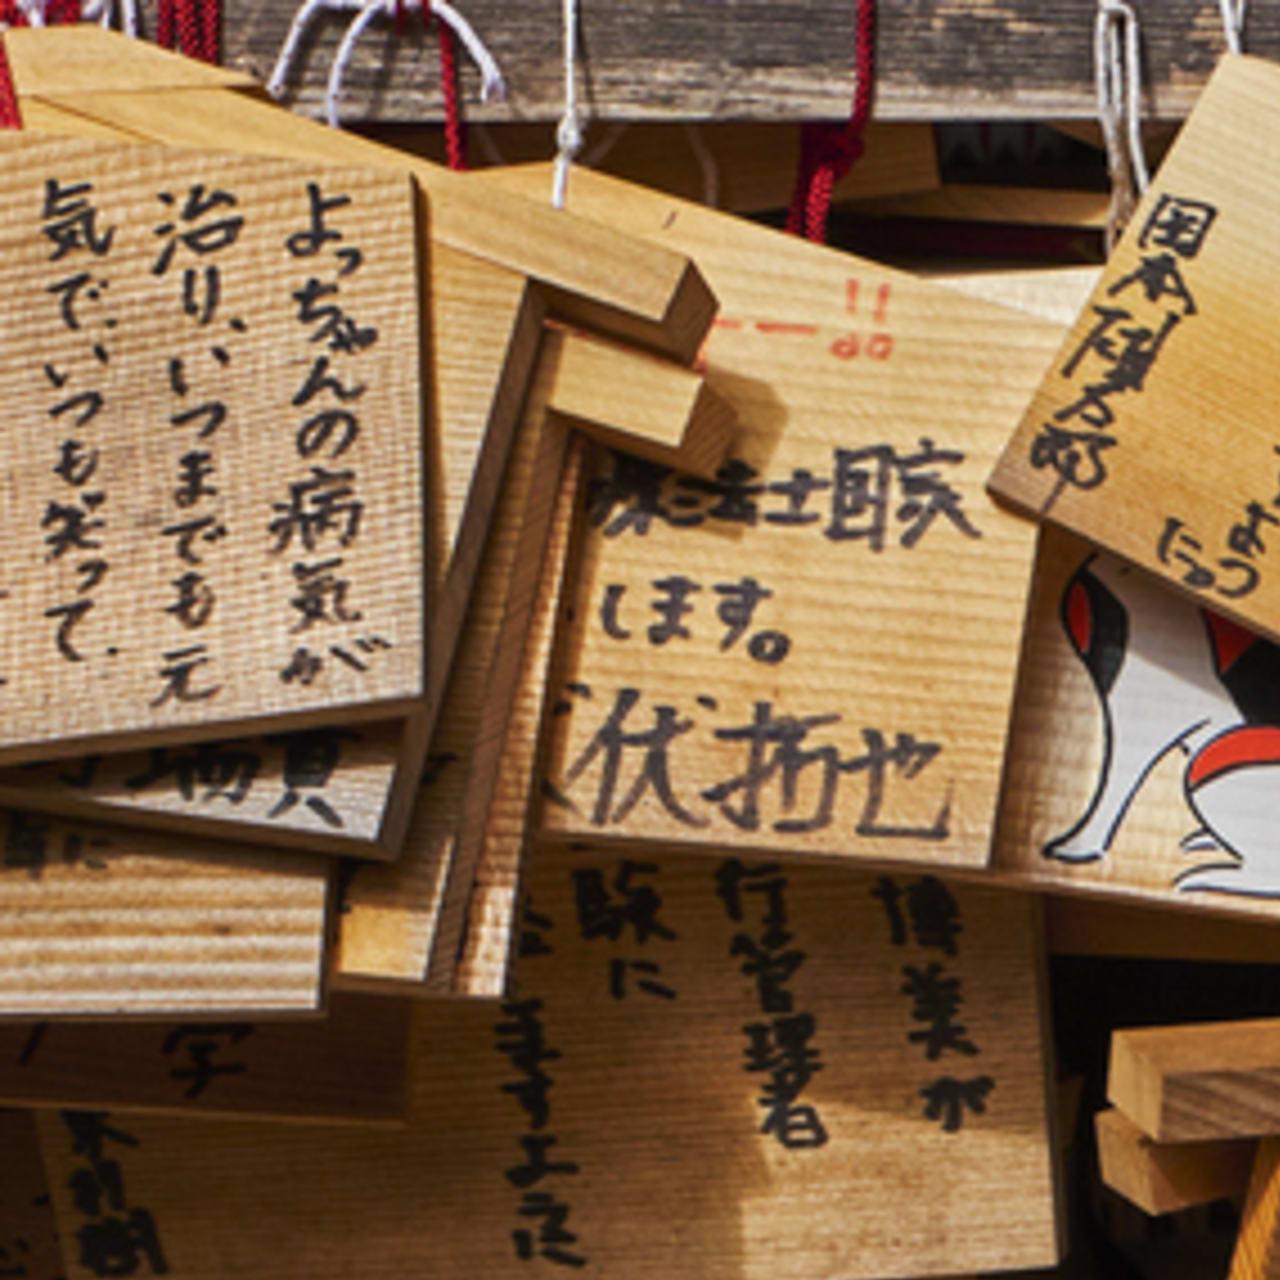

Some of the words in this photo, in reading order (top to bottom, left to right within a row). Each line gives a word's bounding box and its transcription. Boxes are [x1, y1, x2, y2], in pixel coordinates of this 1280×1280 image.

[600, 576, 791, 664] します。
[570, 842, 676, 1000] 験に
